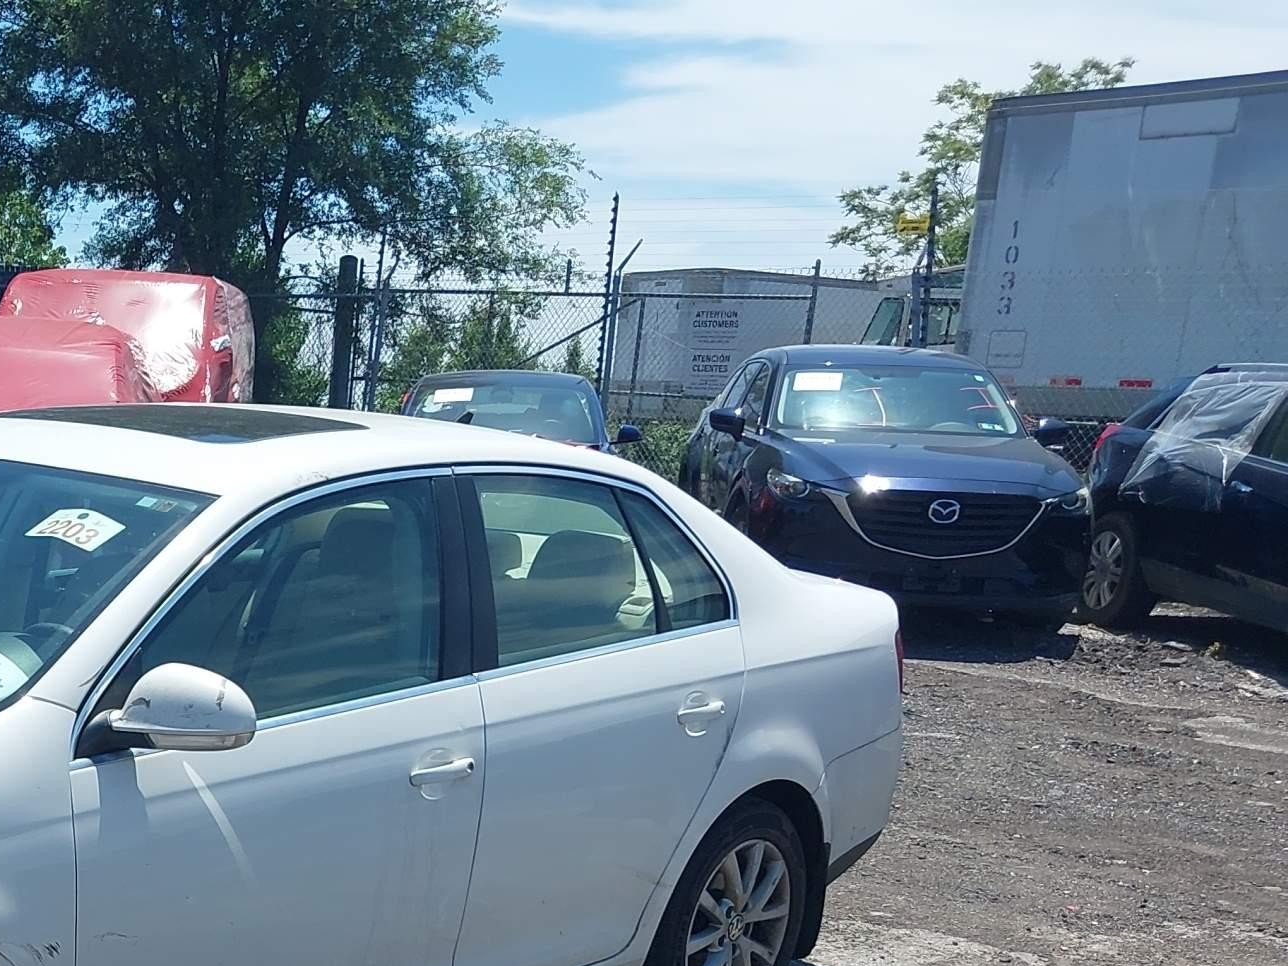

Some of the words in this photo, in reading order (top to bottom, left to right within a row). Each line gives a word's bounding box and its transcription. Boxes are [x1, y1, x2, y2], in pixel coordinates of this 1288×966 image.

[695, 310, 738, 319] ATTENTION
[692, 319, 739, 329] CUSTOMERS
[692, 364, 729, 373] CLIENTES
[36, 519, 100, 545] 2203
